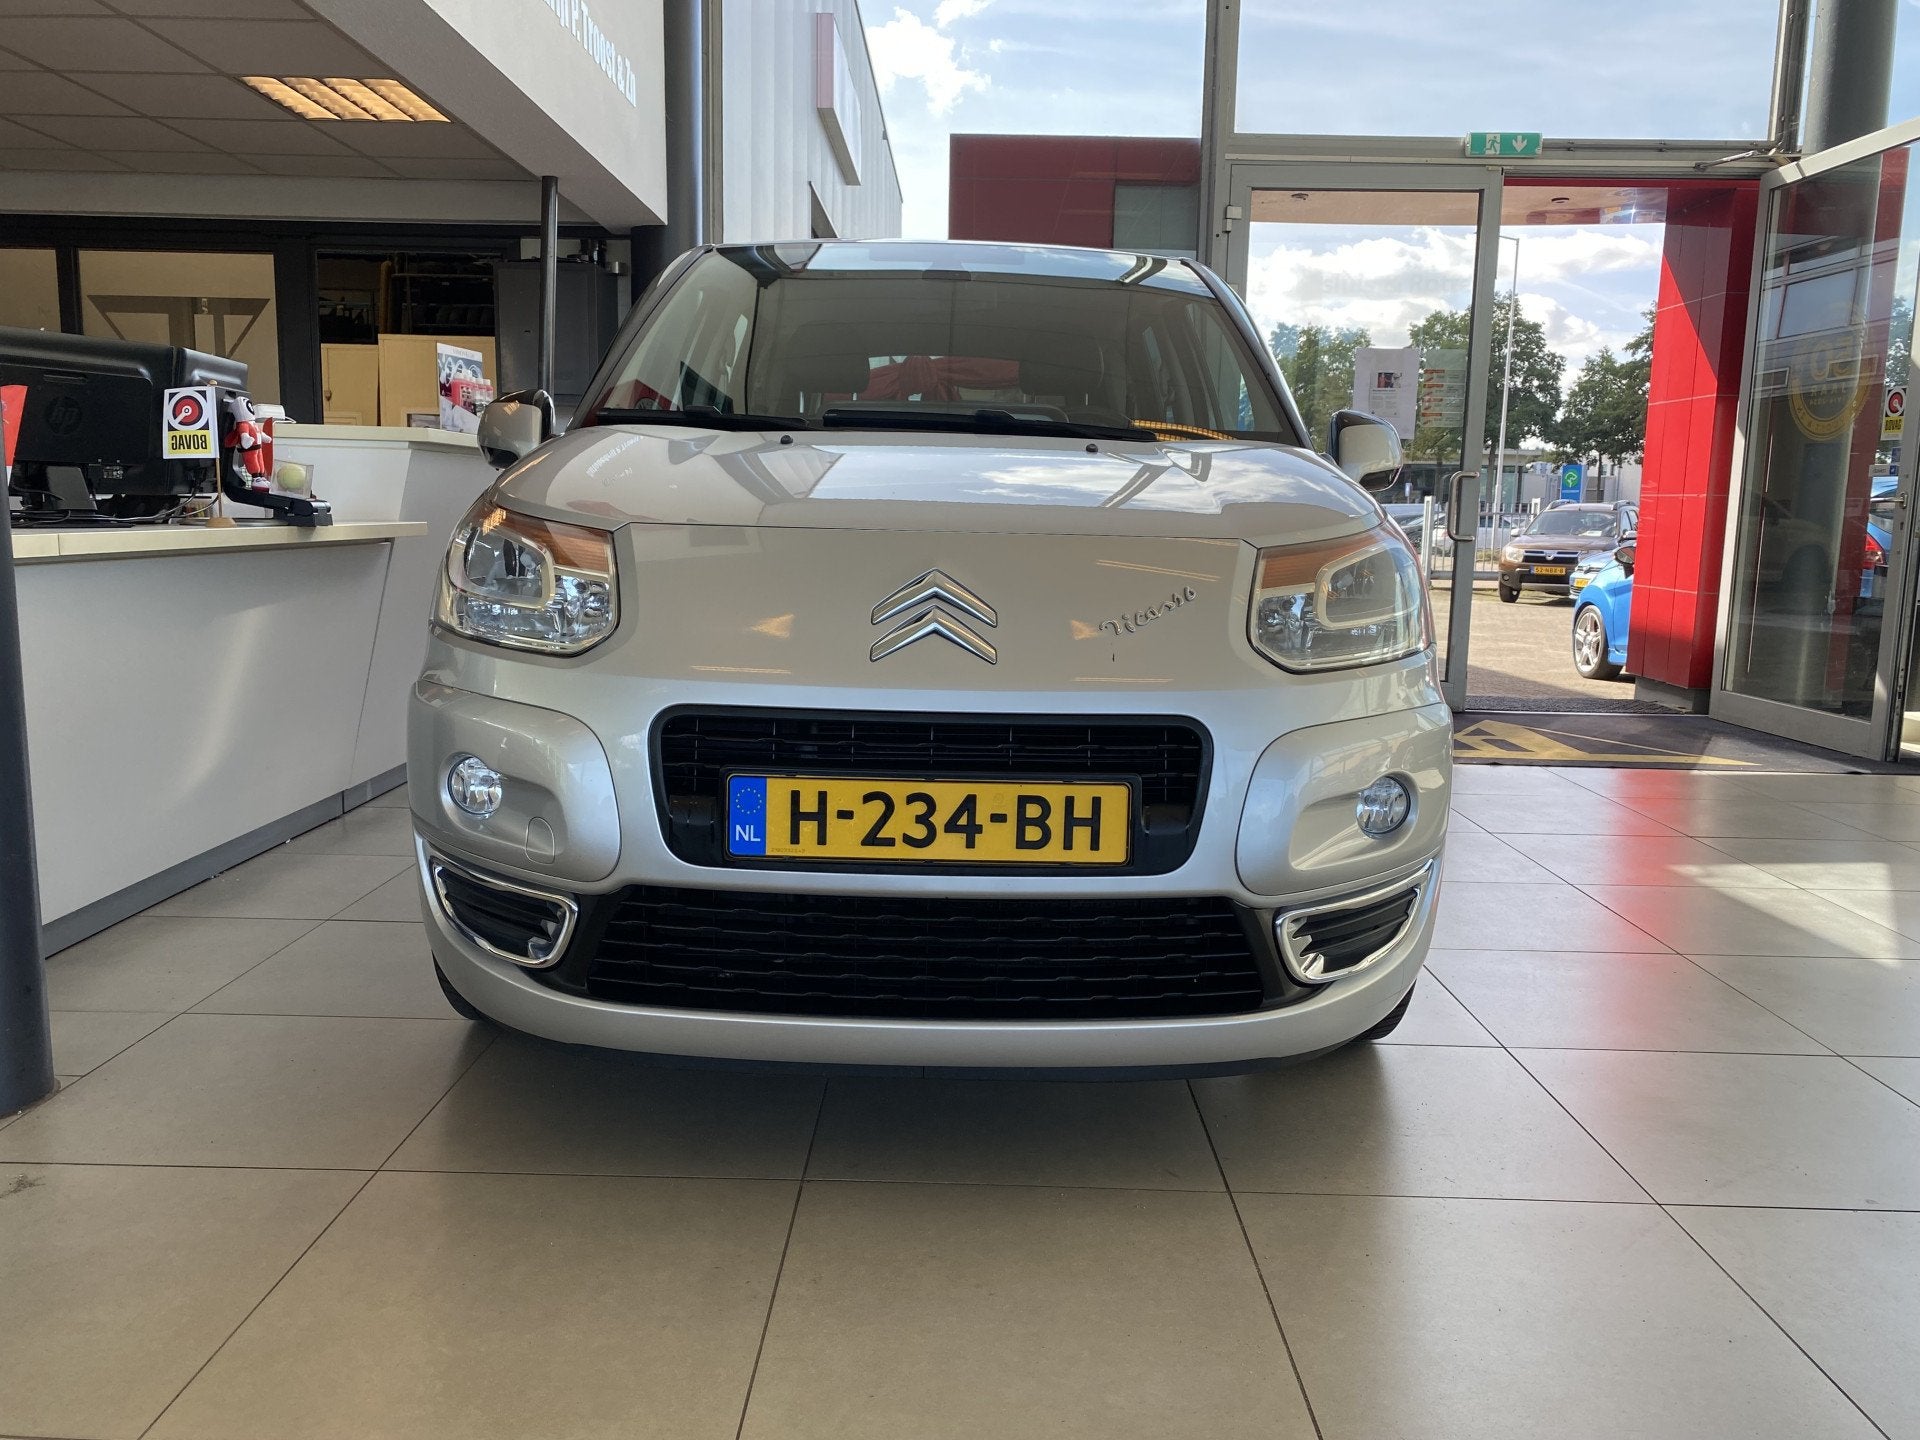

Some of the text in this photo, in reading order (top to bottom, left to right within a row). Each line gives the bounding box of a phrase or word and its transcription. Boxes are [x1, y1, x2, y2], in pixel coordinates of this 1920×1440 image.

[581, 1, 616, 85] Troost
[617, 54, 625, 94] &
[735, 824, 761, 841] NL
[789, 789, 1102, 852] H-234-BH
